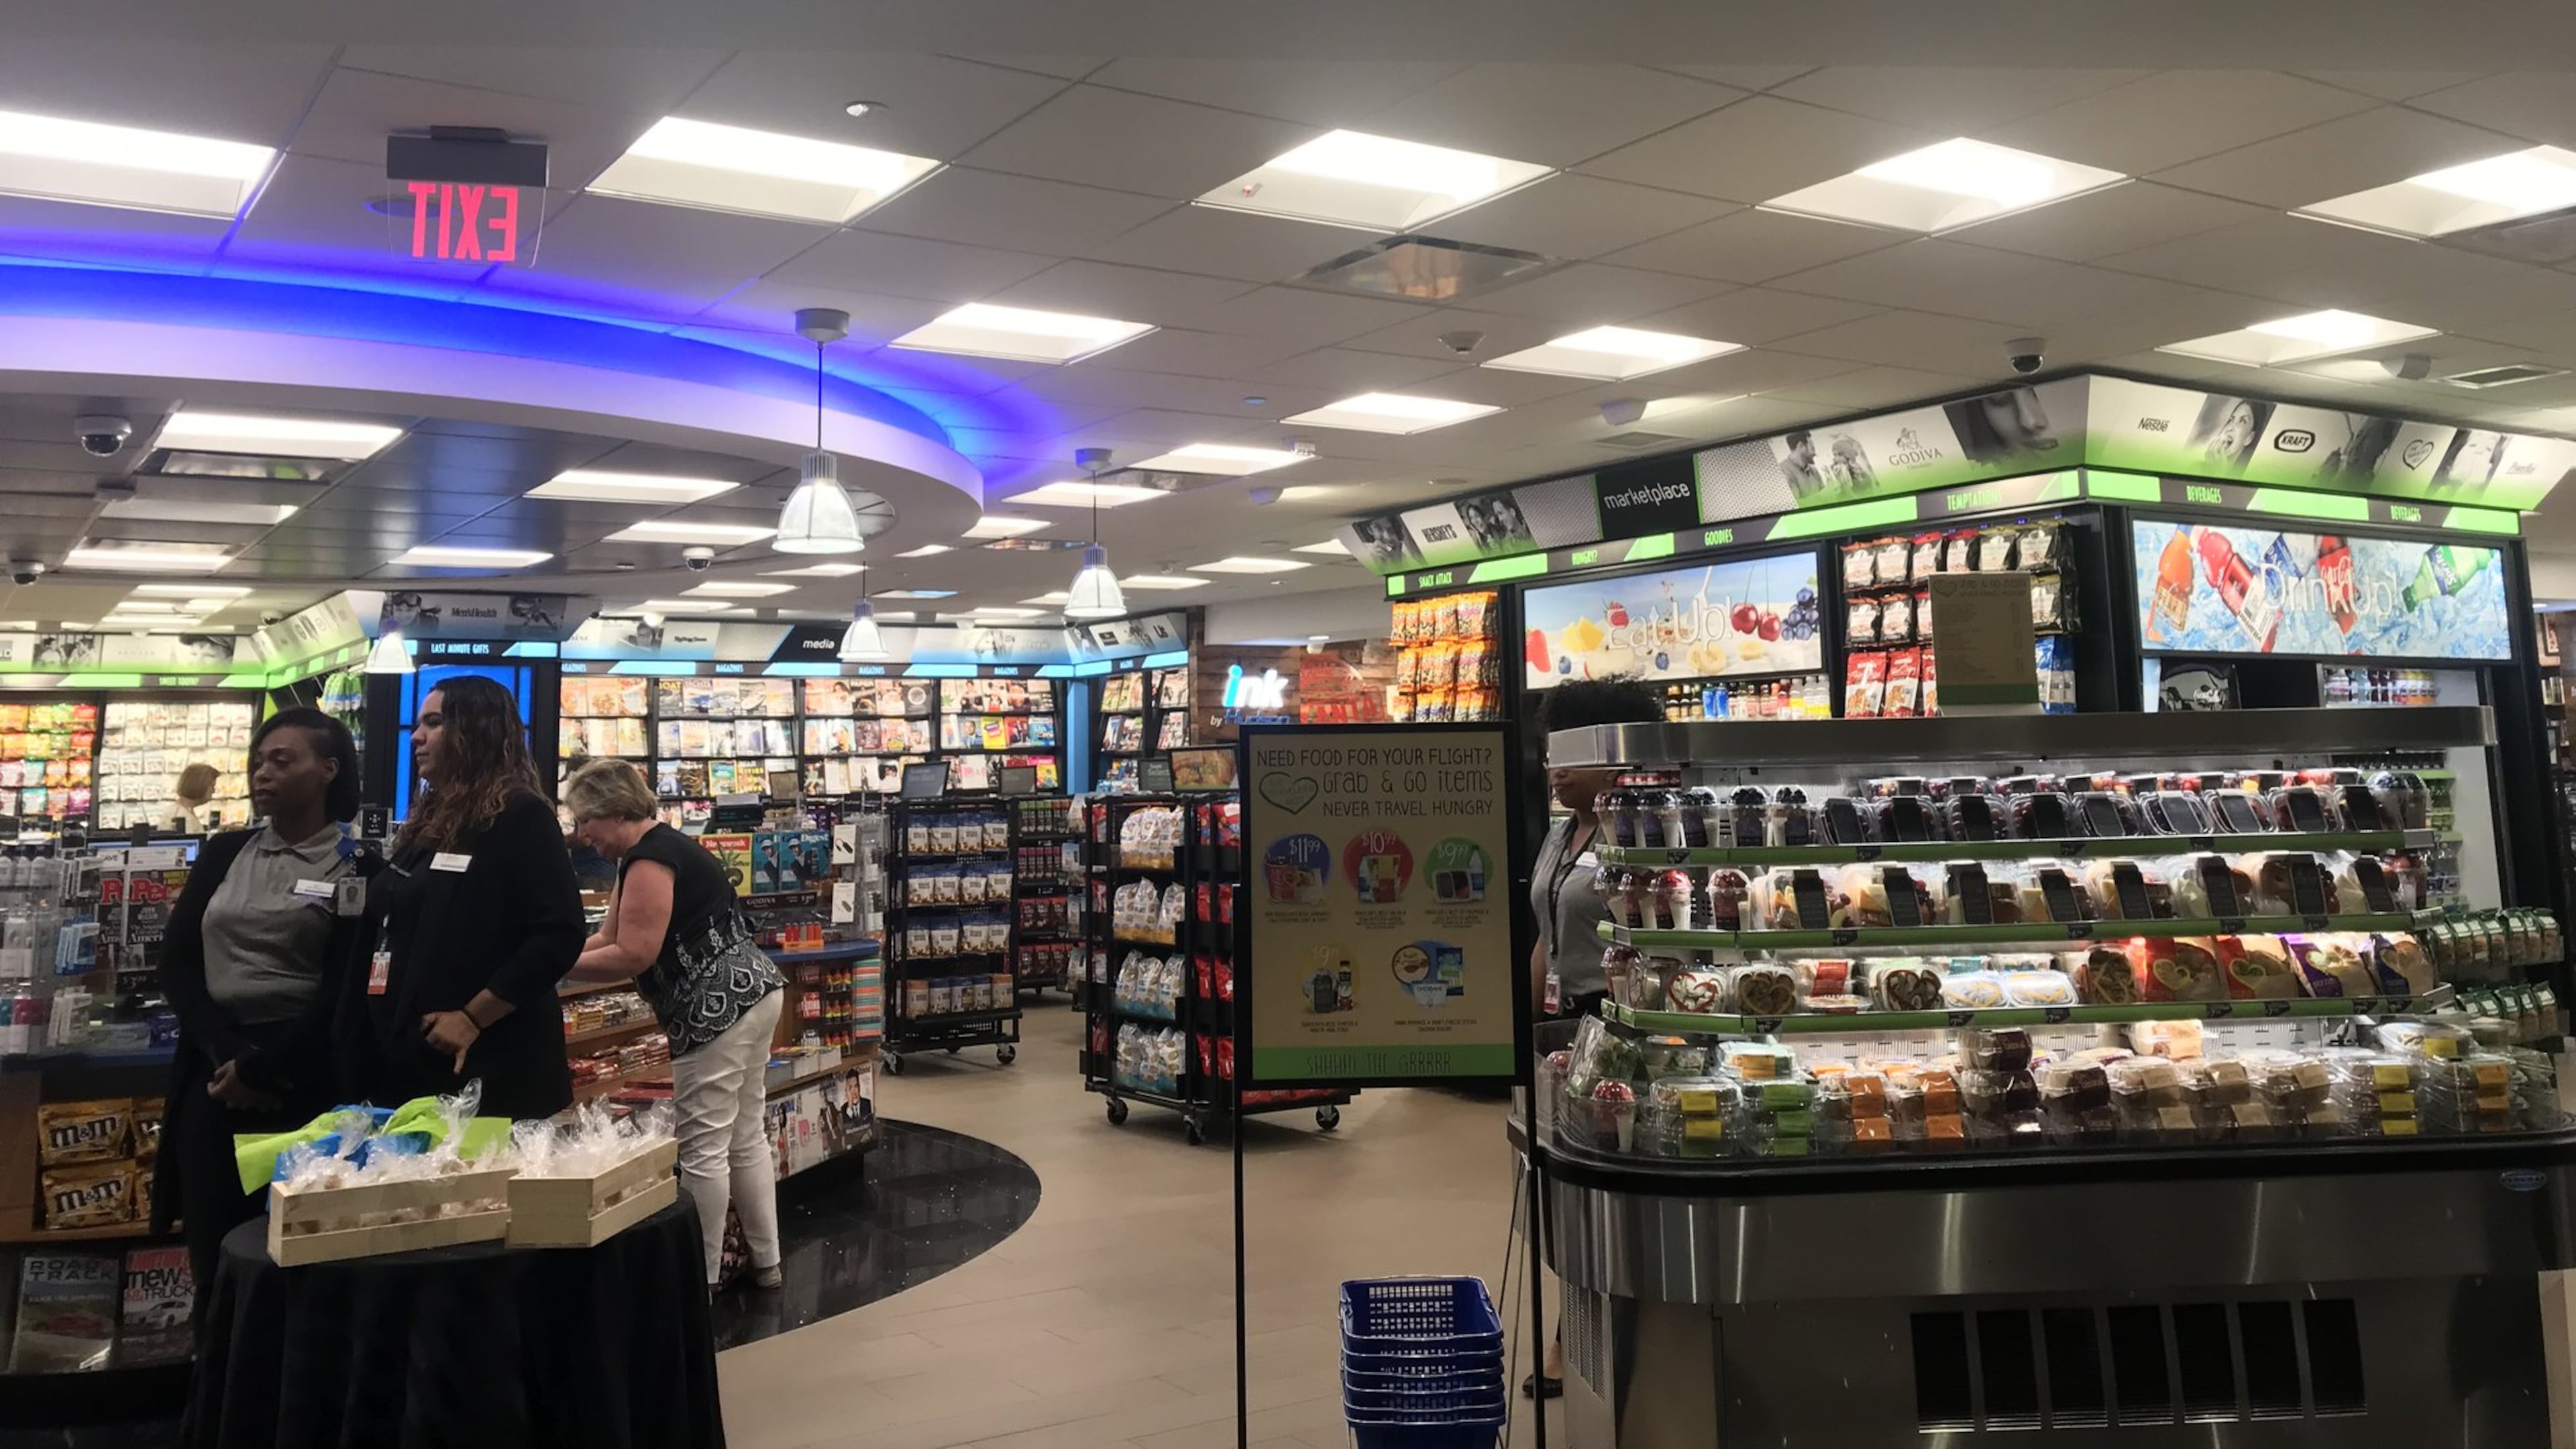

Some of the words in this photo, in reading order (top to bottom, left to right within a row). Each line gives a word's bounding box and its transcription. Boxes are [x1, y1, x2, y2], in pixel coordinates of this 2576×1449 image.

[2281, 435, 2310, 447] KRAFT
[1889, 447, 1943, 466] GODIVA
[1604, 482, 1690, 510] marketplace
[1947, 488, 2002, 512] TEMPTATIONS
[2186, 485, 2222, 504] BEVERAGES
[2390, 505, 2421, 522] BEVERAGES
[1421, 523, 1457, 543] HERSHEY'S
[1705, 529, 1733, 547] GOODIES
[1572, 549, 1598, 566] HUNGRY?
[1419, 574, 1434, 588] SNACK
[1436, 572, 1452, 585] ATTACK
[431, 643, 445, 654] LAST
[447, 643, 470, 655] MINUTE
[472, 643, 489, 655] GIFTS
[802, 639, 835, 649] media
[716, 664, 744, 673] MAGAZINES
[858, 666, 885, 676] MAGAZINES
[994, 666, 1018, 676] MAGAZINES
[1222, 664, 1289, 708] ink
[1210, 715, 1222, 727] by
[1224, 708, 1291, 725] Hudson
[1257, 750, 1295, 766] NEED
[1300, 749, 1342, 766] FOOD
[1347, 749, 1378, 765] FOR
[1381, 748, 1424, 765] YOUR
[1428, 747, 1493, 765] FLIGHT?
[1323, 770, 1368, 794] Grab
[1381, 770, 1394, 794] &
[1403, 770, 1428, 793] GO
[1438, 769, 1493, 793] items
[1323, 800, 1370, 817] NEVER
[1374, 800, 1428, 817] TRAVEL
[1432, 799, 1493, 817] HUNGRY
[800, 833, 830, 844] Digest
[1366, 1053, 1387, 1075] THE
[30, 1259, 99, 1271] ROAD
[30, 1270, 114, 1281] TRACK
